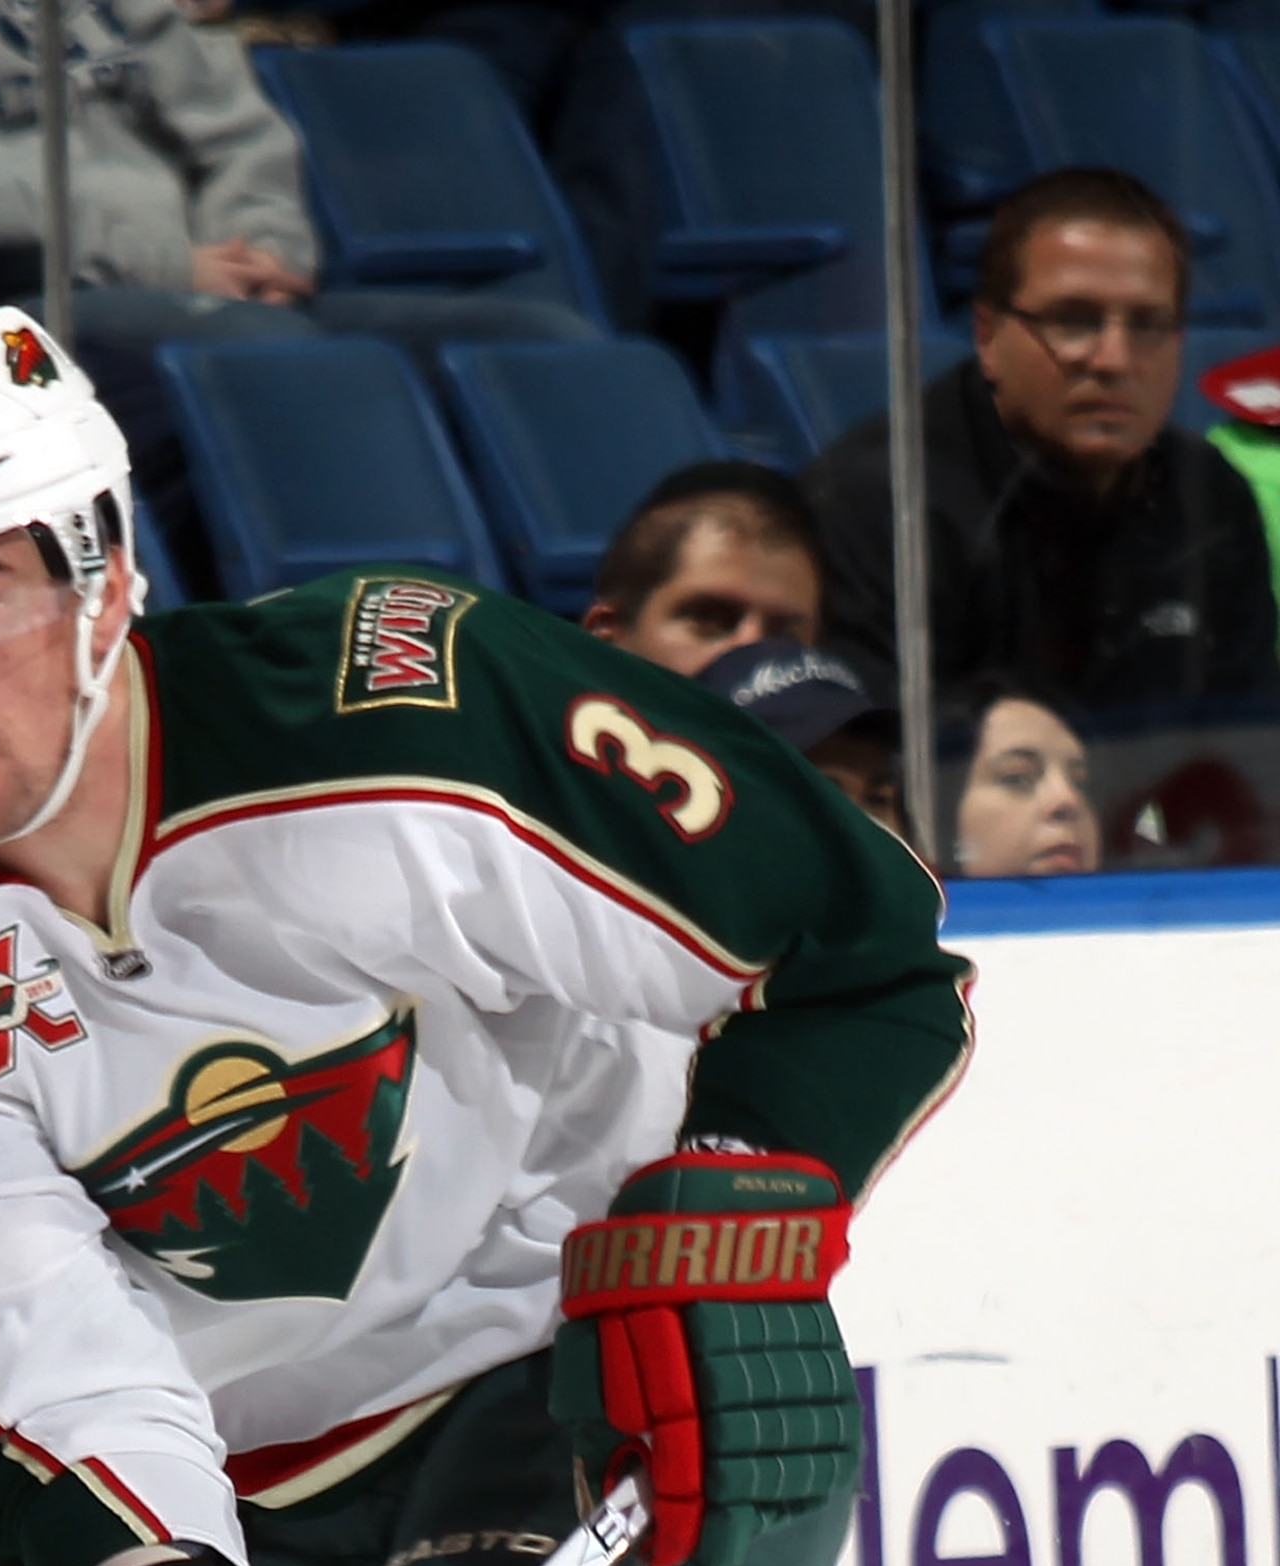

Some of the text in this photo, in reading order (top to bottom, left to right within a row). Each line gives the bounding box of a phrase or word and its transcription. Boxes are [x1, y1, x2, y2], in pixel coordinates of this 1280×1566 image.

[365, 583, 456, 692] WILD
[564, 691, 735, 844] 3
[563, 1214, 822, 1298] ARRIOR
